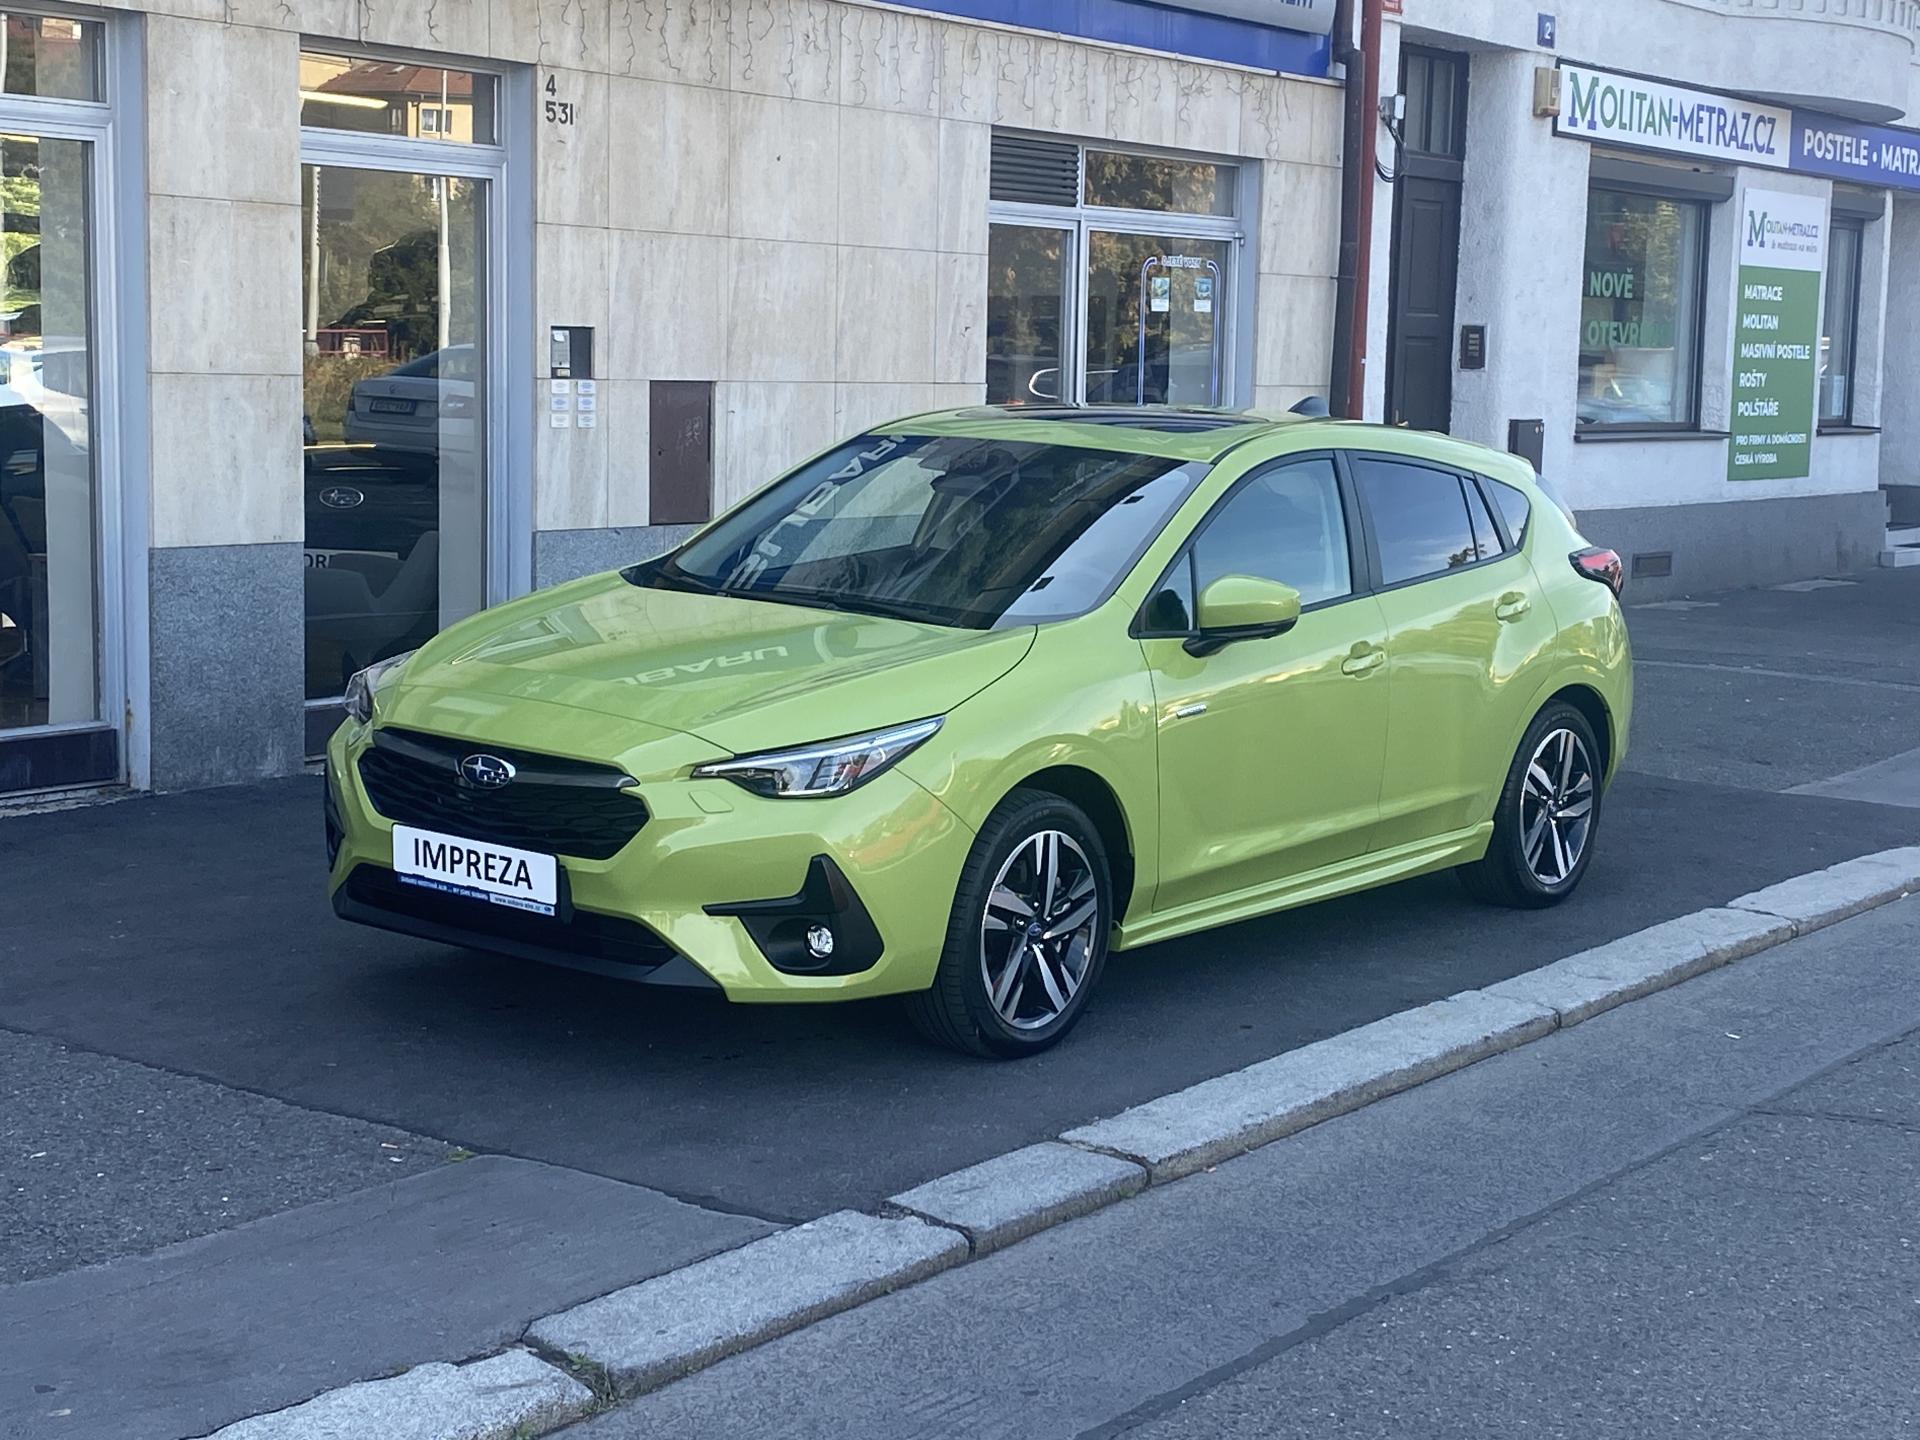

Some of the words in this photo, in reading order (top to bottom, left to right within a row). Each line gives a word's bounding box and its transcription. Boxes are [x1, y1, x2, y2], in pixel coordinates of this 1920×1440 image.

[1544, 21, 1552, 40] 2
[545, 74, 557, 97] 4
[545, 100, 574, 126] 531
[1568, 72, 1777, 155] MOLITAN-METRAZ.CZ
[1803, 128, 1869, 167] POSTELE
[1880, 143, 1920, 176] MATR
[1590, 267, 1634, 299] NOVĚ
[1744, 284, 1783, 301] MATRACE
[1742, 313, 1779, 330] MOLITAN
[1740, 340, 1776, 359] MASIVNÍ
[1776, 344, 1810, 360] POSTELE
[1739, 368, 1767, 388] ROŠTY
[1737, 397, 1779, 417] POLŠTÁŘE
[414, 837, 533, 891] IMPREZA
